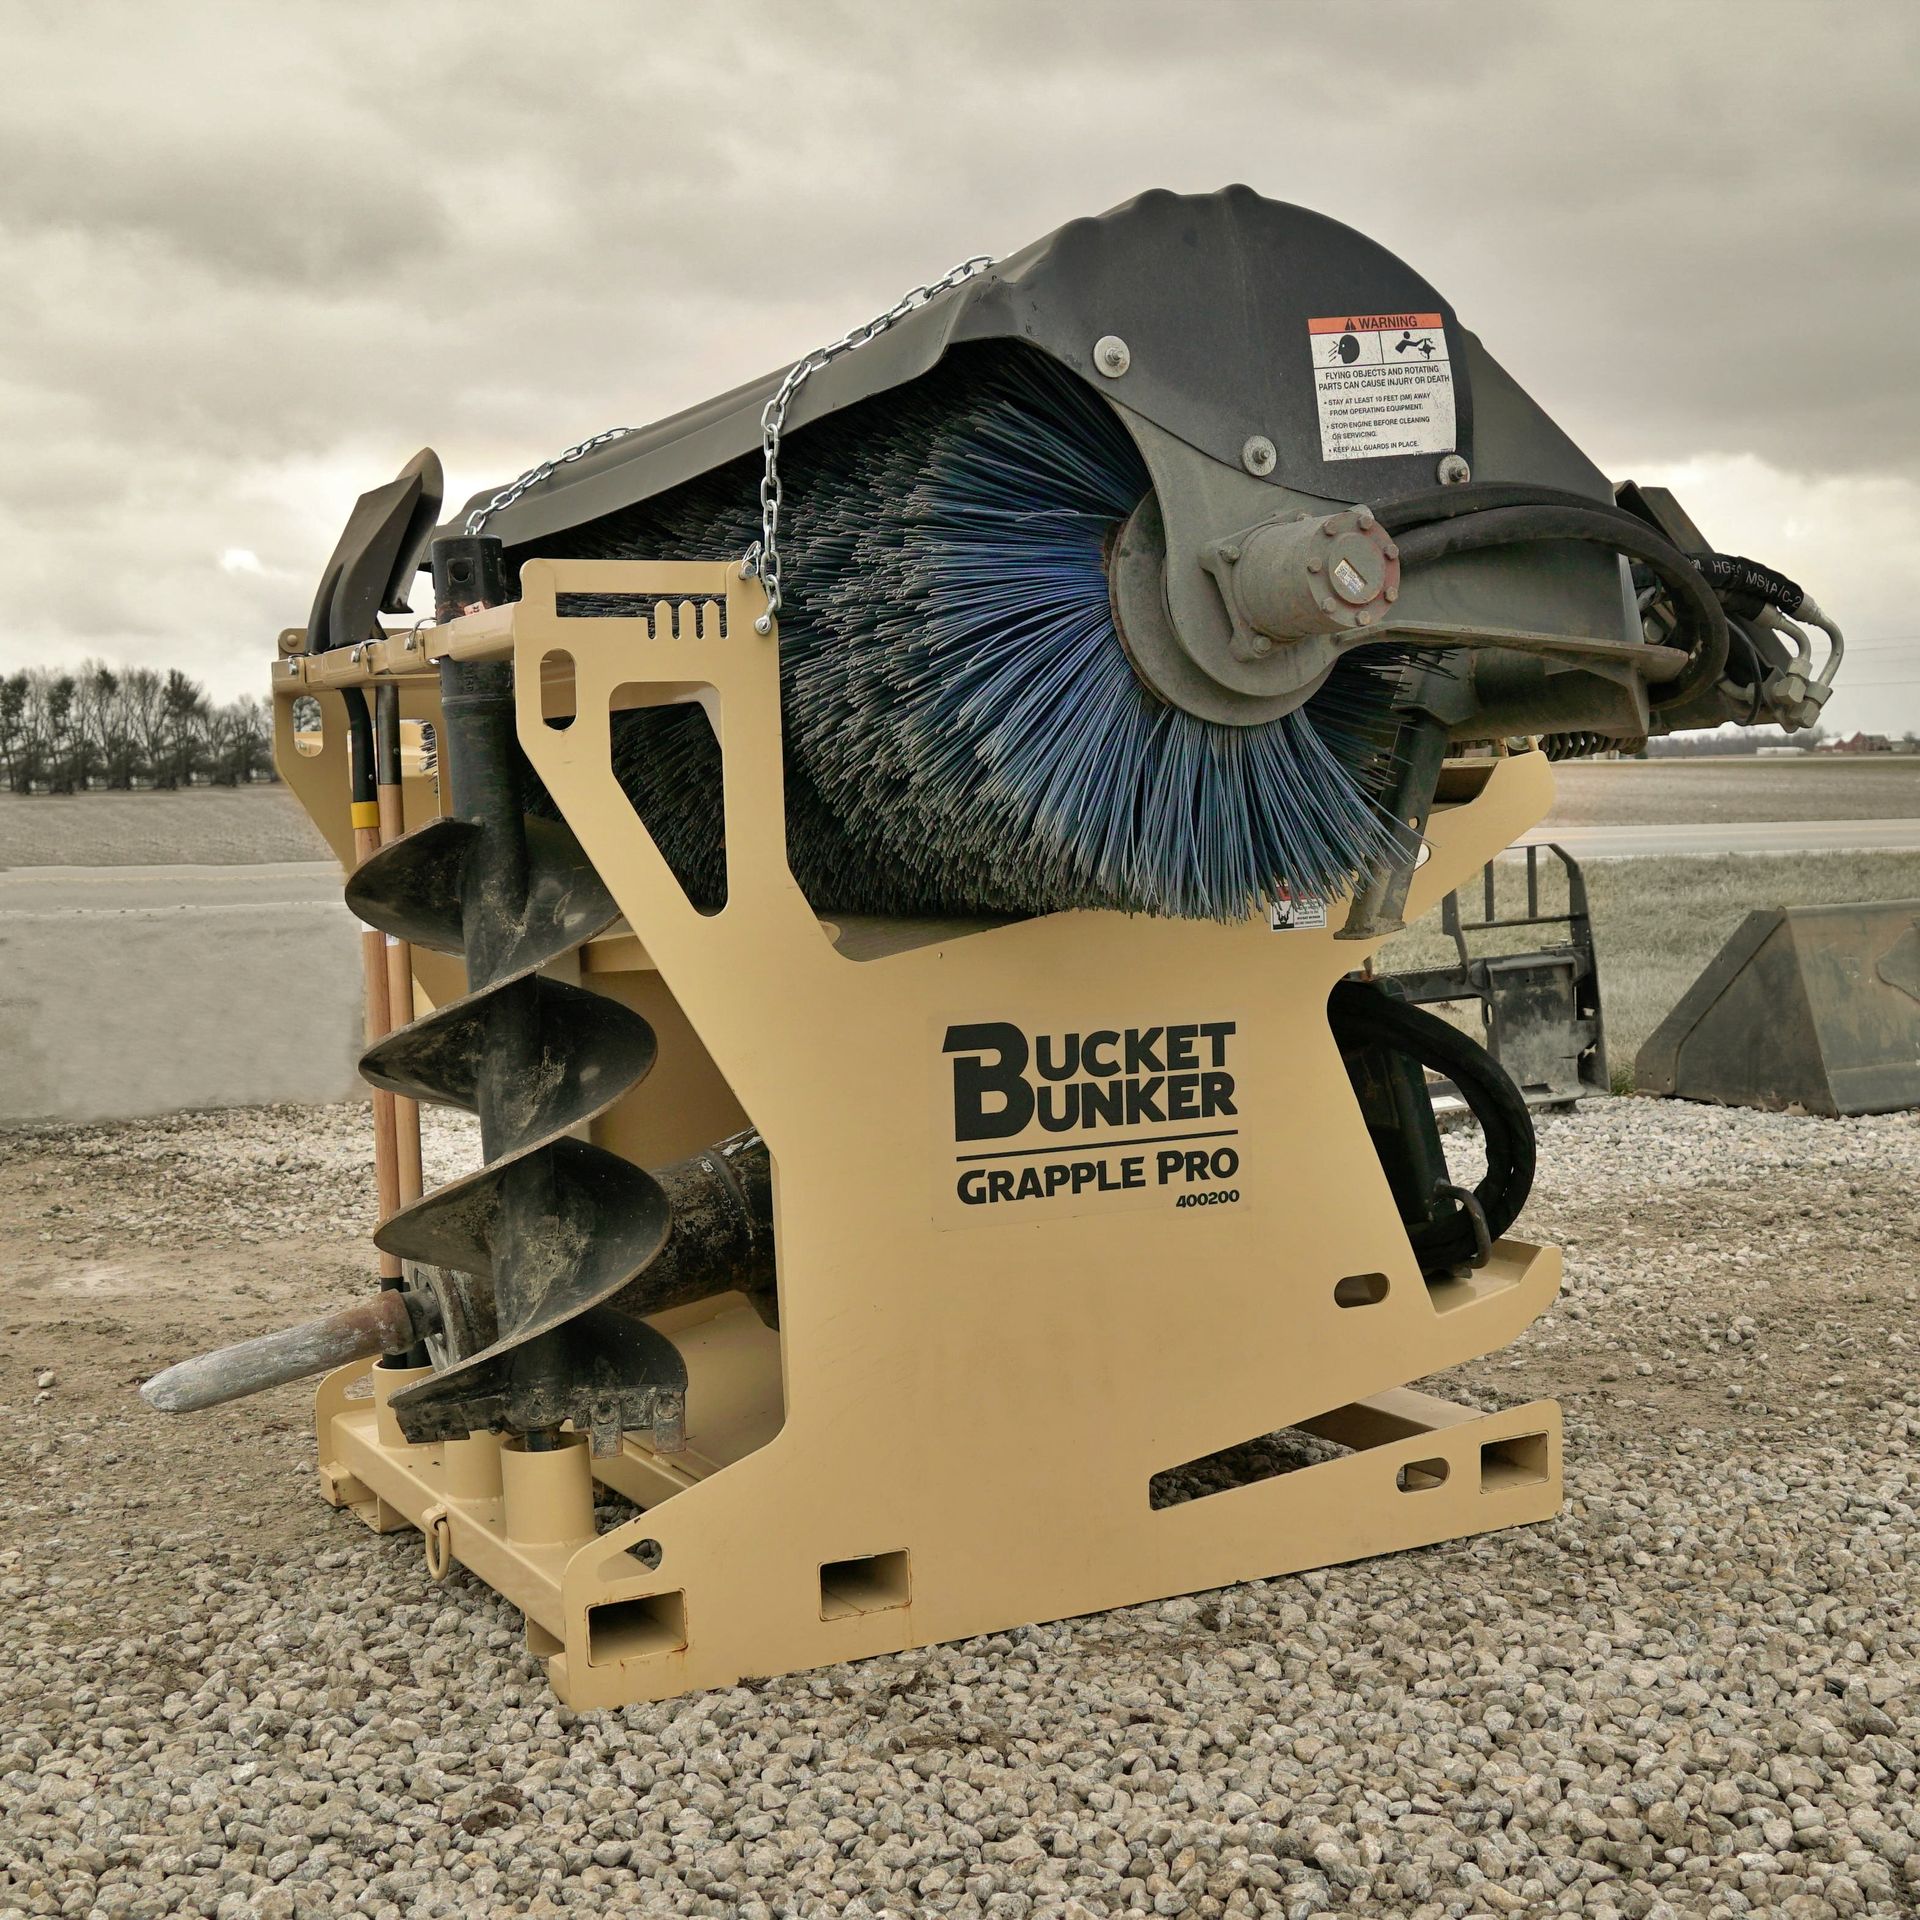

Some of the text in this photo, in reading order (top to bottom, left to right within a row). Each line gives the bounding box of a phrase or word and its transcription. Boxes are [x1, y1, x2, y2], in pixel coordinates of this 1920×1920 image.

[1358, 316, 1418, 329] WARNING
[1325, 365, 1440, 380] FLYING OBJECTS AND ROTATING
[1318, 375, 1450, 391] PARTS CAN CAUSE INJURY OR DEATH
[1328, 398, 1344, 406] STAY
[1345, 397, 1353, 405] AT
[1354, 396, 1374, 404] LEAST
[1383, 395, 1398, 403] FEET
[1413, 392, 1431, 400] AWAY
[1330, 403, 1424, 417] FROM OPERATING EQUIPMENT.
[1330, 416, 1430, 430] STOP ENGINE BEFORE CLEANING
[1331, 432, 1342, 441] OR
[1333, 440, 1420, 454] KEEP ALL GUARDS IN PLACE.
[942, 1021, 1237, 1084] BUCKET
[956, 1147, 1240, 1205] GRAPPLE PRO
[1175, 1189, 1241, 1209] 400200
